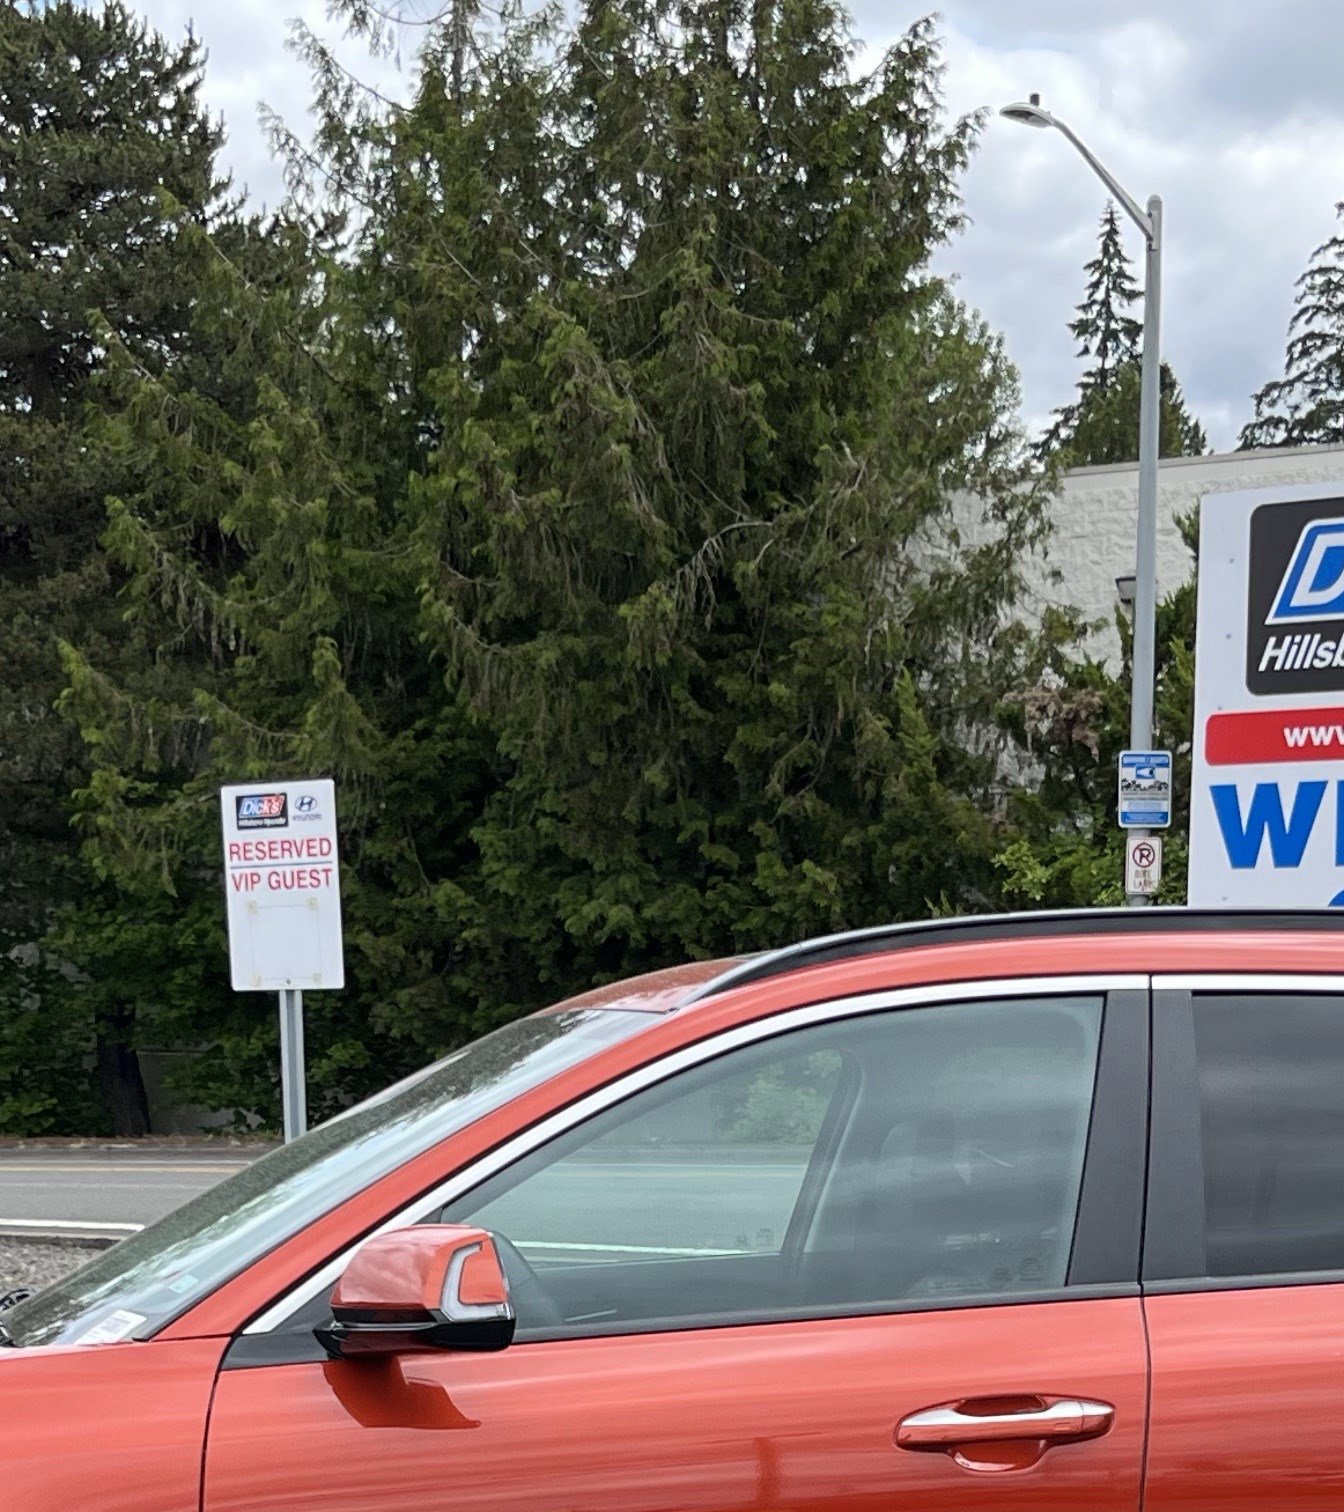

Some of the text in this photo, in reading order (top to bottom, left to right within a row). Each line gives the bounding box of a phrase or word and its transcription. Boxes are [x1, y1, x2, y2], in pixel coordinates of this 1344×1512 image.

[229, 837, 332, 863] RESERVED
[231, 868, 333, 892] VIP GUEST
